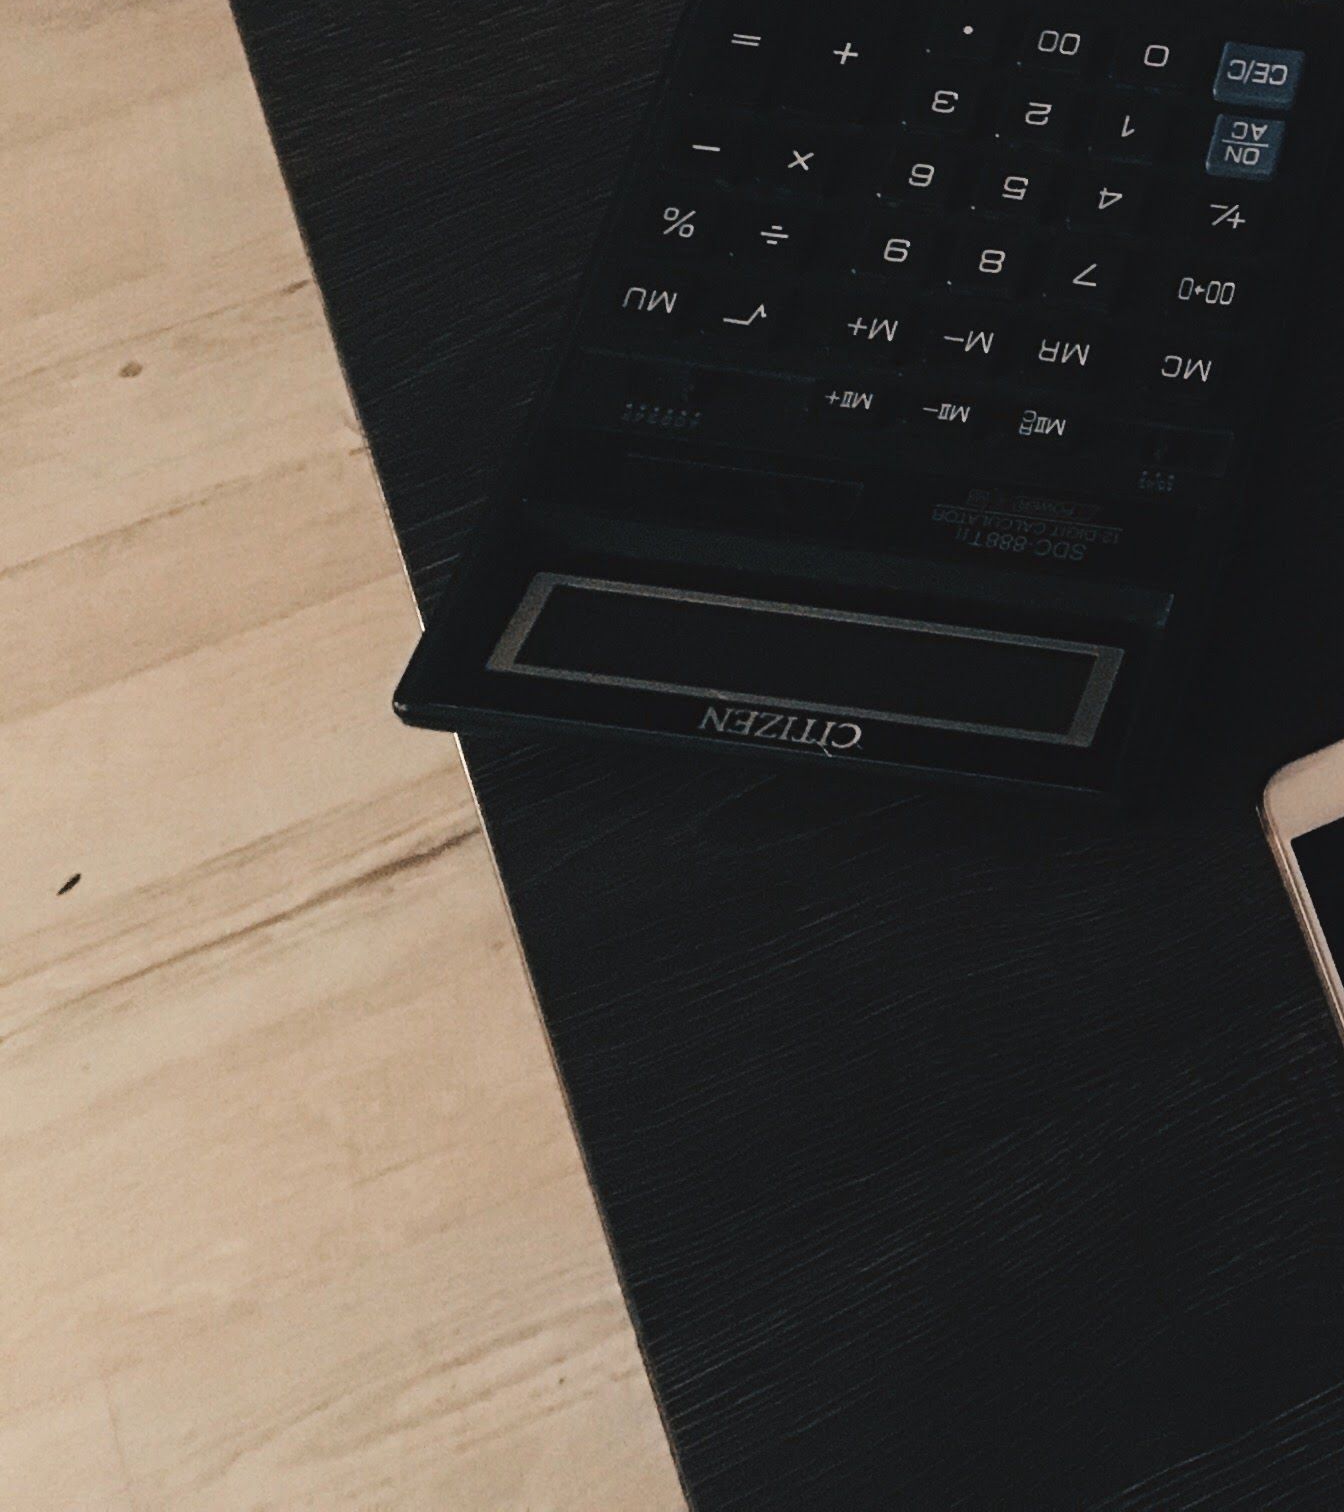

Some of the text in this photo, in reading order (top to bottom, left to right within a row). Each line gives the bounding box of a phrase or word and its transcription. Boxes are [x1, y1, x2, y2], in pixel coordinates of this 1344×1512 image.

[1038, 31, 1080, 55] 00
[1144, 45, 1169, 67] 0
[1226, 58, 1288, 86] CE/C
[932, 90, 1270, 141] 3 2 1 AC
[909, 164, 934, 187] 6
[1002, 177, 1028, 200] 5
[1099, 188, 1122, 209] 4
[1226, 145, 1262, 166] ON
[884, 239, 910, 262] 9
[979, 250, 1005, 273] 8
[1073, 264, 1096, 286] 7
[623, 287, 1211, 382] MU M+ M- MR MC
[698, 706, 862, 749] CITIZEN
